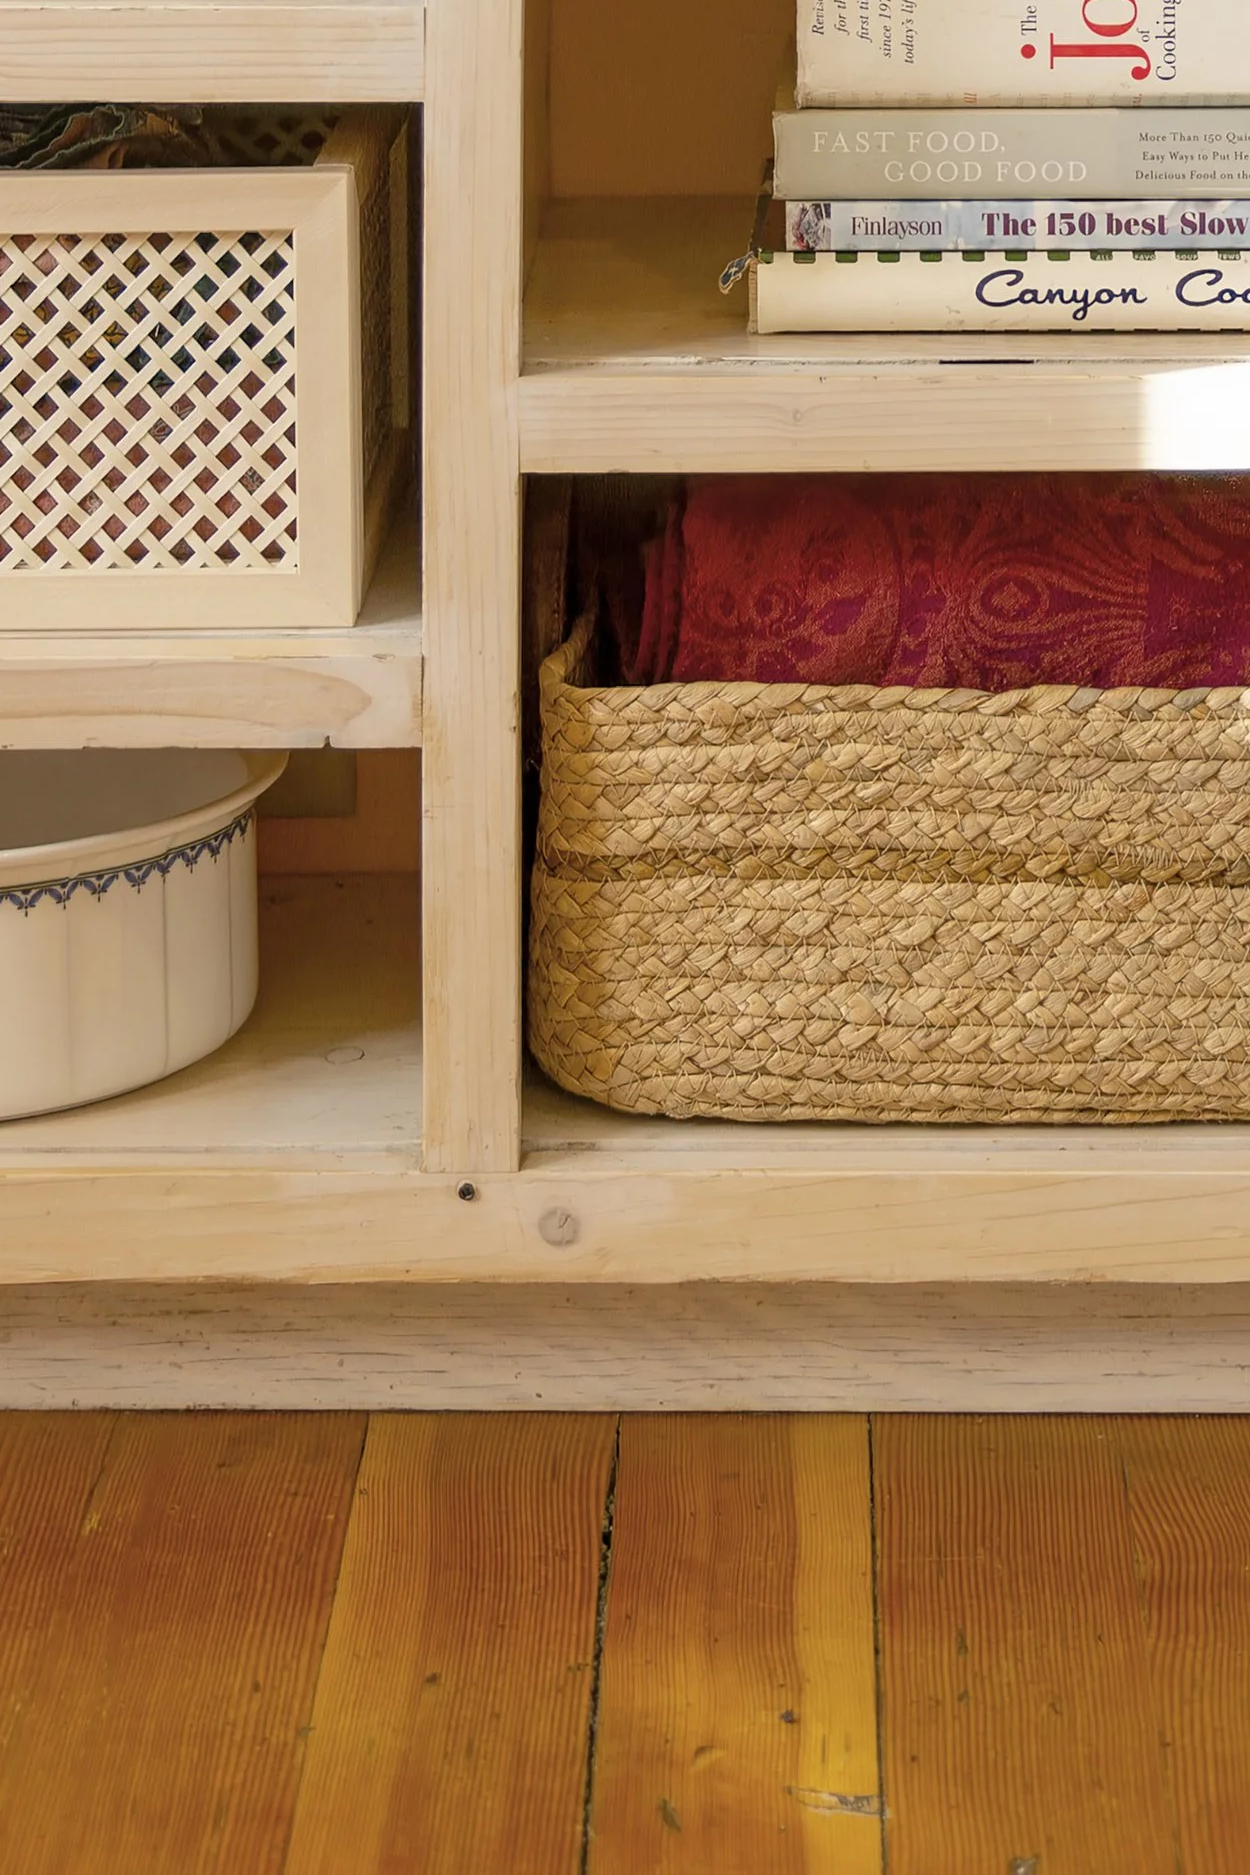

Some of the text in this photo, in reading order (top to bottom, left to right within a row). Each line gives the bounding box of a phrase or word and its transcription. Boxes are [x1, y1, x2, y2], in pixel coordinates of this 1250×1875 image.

[834, 15, 850, 35] for
[856, 15, 873, 43] first
[1020, 5, 1037, 35] The
[879, 25, 892, 58] since
[901, 19, 918, 64] today's
[1136, 28, 1150, 43] of
[812, 131, 1006, 154] FAST FOOD,
[1138, 132, 1167, 142] More
[1170, 132, 1199, 142] Than
[1203, 133, 1222, 144] 150
[1142, 151, 1165, 163] Easy
[1169, 151, 1194, 163] Ways
[1198, 153, 1208, 161] to
[1212, 151, 1230, 161] Put
[884, 161, 1088, 182] GOOD FOOD
[1135, 170, 1186, 180] Delicious
[1190, 170, 1216, 180] Food
[1220, 172, 1234, 180] on
[851, 216, 942, 239] Finlayson
[982, 212, 1037, 236] The
[1045, 212, 1096, 236] 150
[1105, 212, 1169, 236] best
[1180, 211, 1249, 236] Slow
[975, 268, 1148, 321] Canyon
